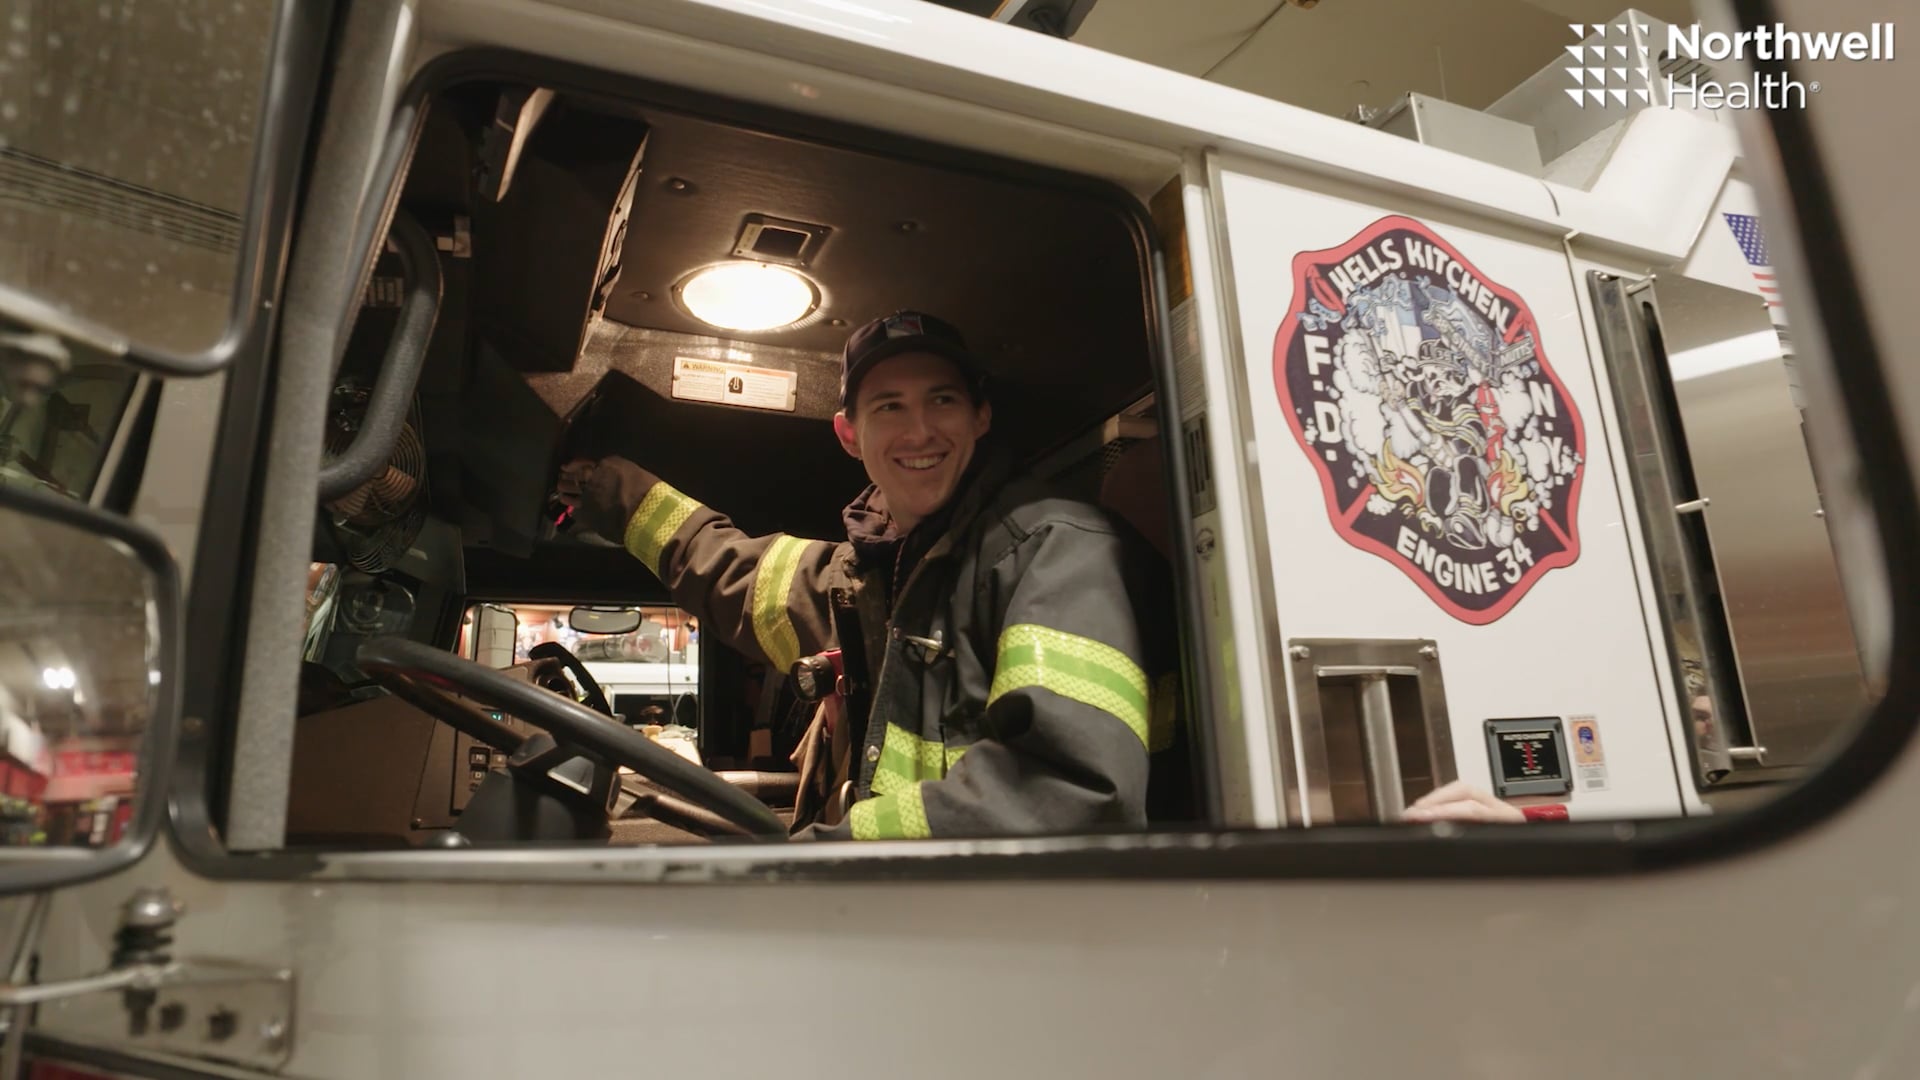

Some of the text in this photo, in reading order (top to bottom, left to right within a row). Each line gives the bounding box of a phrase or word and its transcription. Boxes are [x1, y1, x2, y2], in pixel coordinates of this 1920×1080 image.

[1327, 237, 1510, 335] HELLS KITCHEN
[1396, 525, 1535, 595] ENGINE 34
